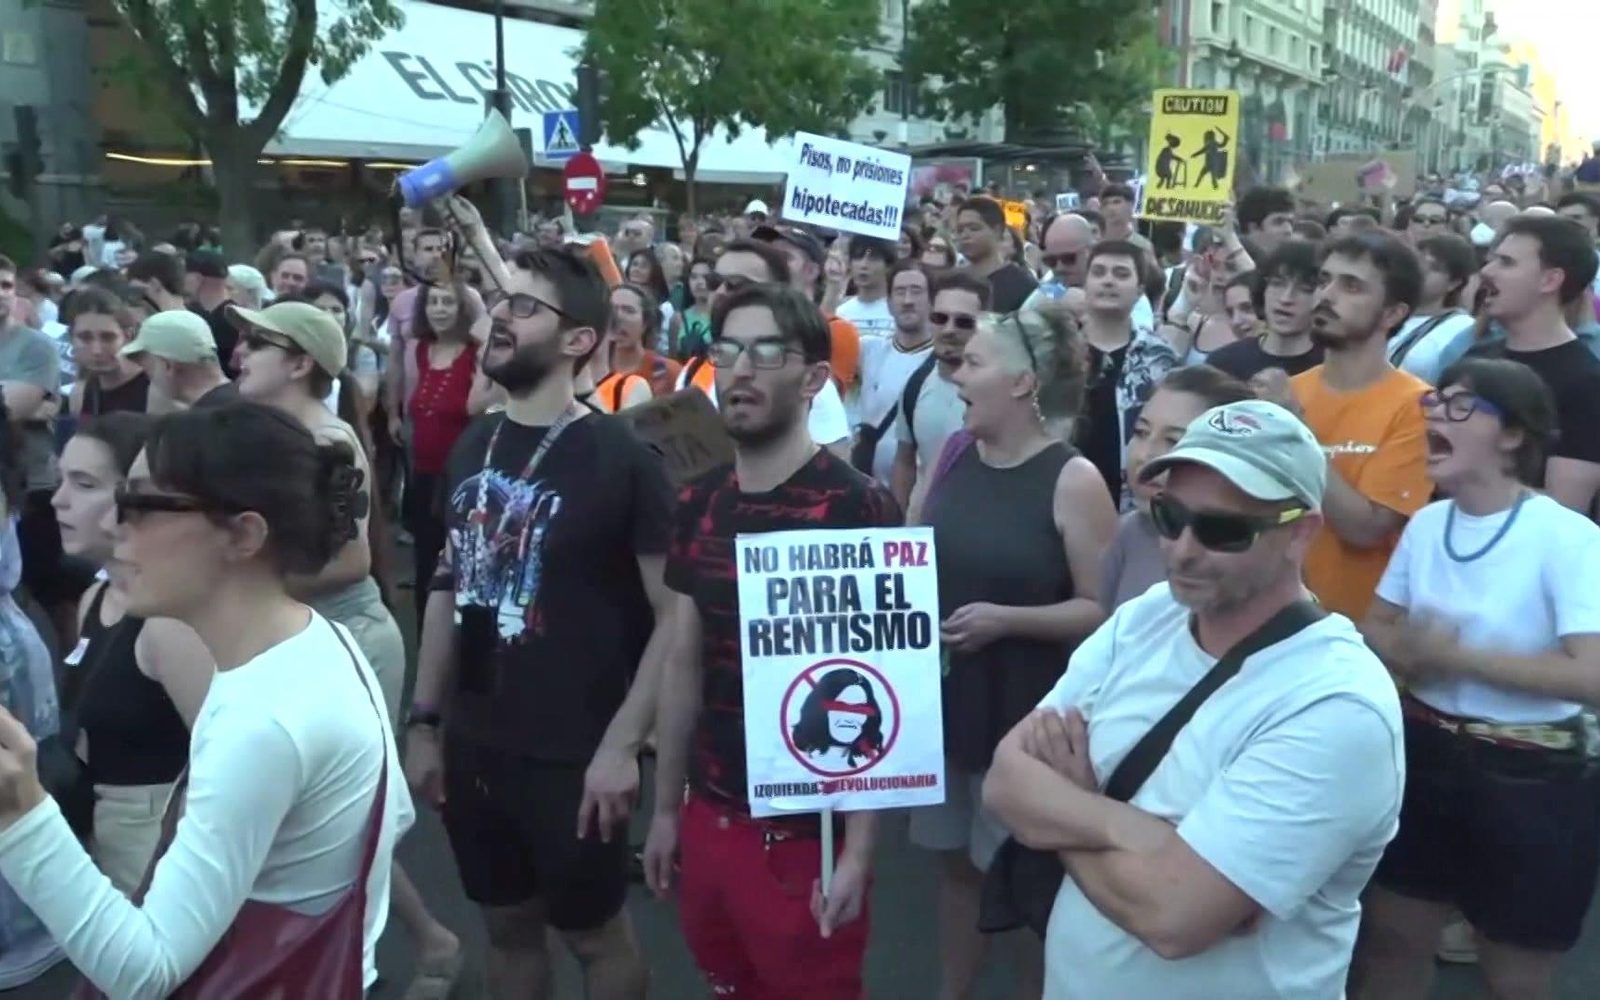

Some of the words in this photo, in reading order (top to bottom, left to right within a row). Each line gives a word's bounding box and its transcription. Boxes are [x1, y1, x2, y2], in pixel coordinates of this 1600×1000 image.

[380, 51, 478, 104] EL
[1164, 96, 1226, 114] CAUTION
[800, 143, 833, 176] Pisos,
[837, 156, 851, 173] no
[853, 157, 903, 186] prisiones
[792, 186, 899, 227] hipotecadas!!!
[744, 547, 779, 573] NO
[789, 537, 875, 571] HABRÁ
[883, 541, 928, 567] PAZ
[767, 575, 862, 616] PARA
[875, 573, 911, 611] EL
[749, 611, 931, 657] RENTISMO
[754, 783, 819, 798] IZQUIERDA
